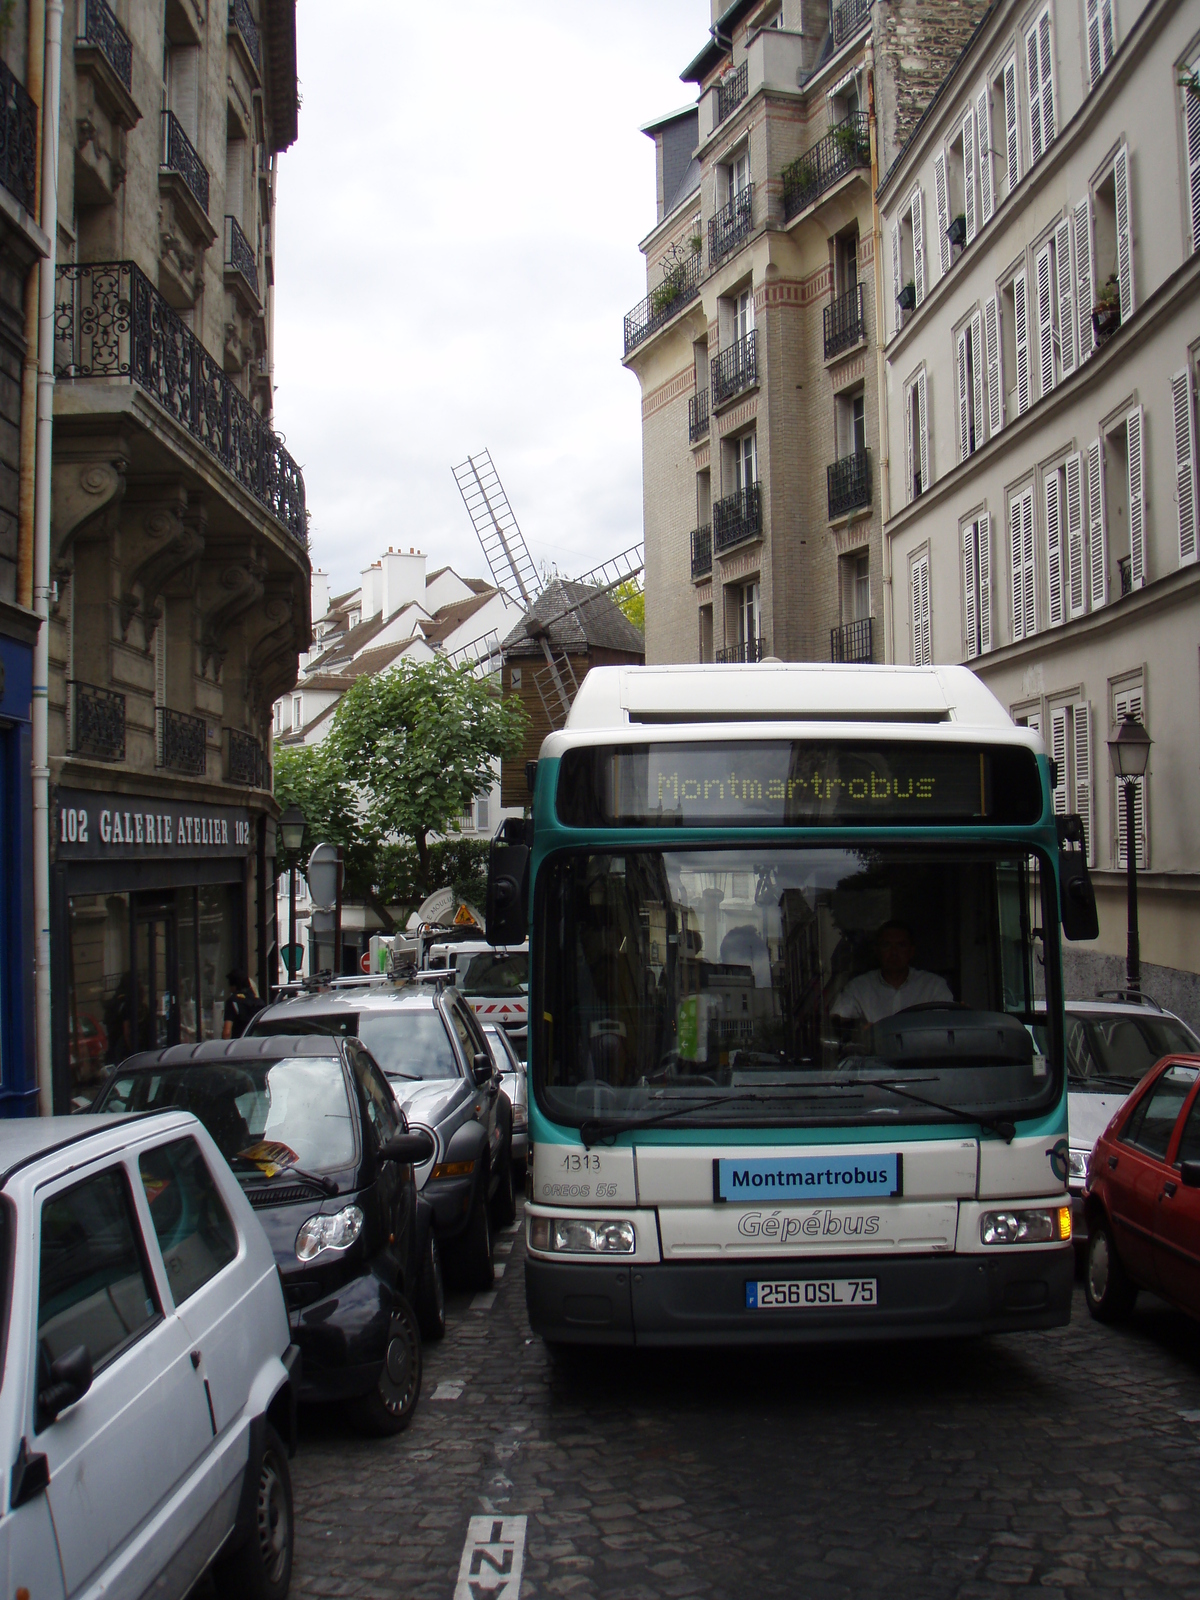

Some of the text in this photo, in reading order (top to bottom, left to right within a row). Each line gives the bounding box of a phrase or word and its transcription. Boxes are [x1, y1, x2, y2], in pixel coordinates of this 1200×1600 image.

[657, 771, 936, 799] Montmartrobus
[61, 807, 250, 845] 102 GALERIE ATELIER 102
[562, 1154, 601, 1171] 1313
[732, 1167, 888, 1187] Montmartrobus
[542, 1183, 618, 1198] OREOS 55
[737, 1209, 880, 1242] Gépébus
[761, 1284, 800, 1305] 256
[804, 1282, 844, 1304] QSL
[848, 1281, 874, 1302] 75
